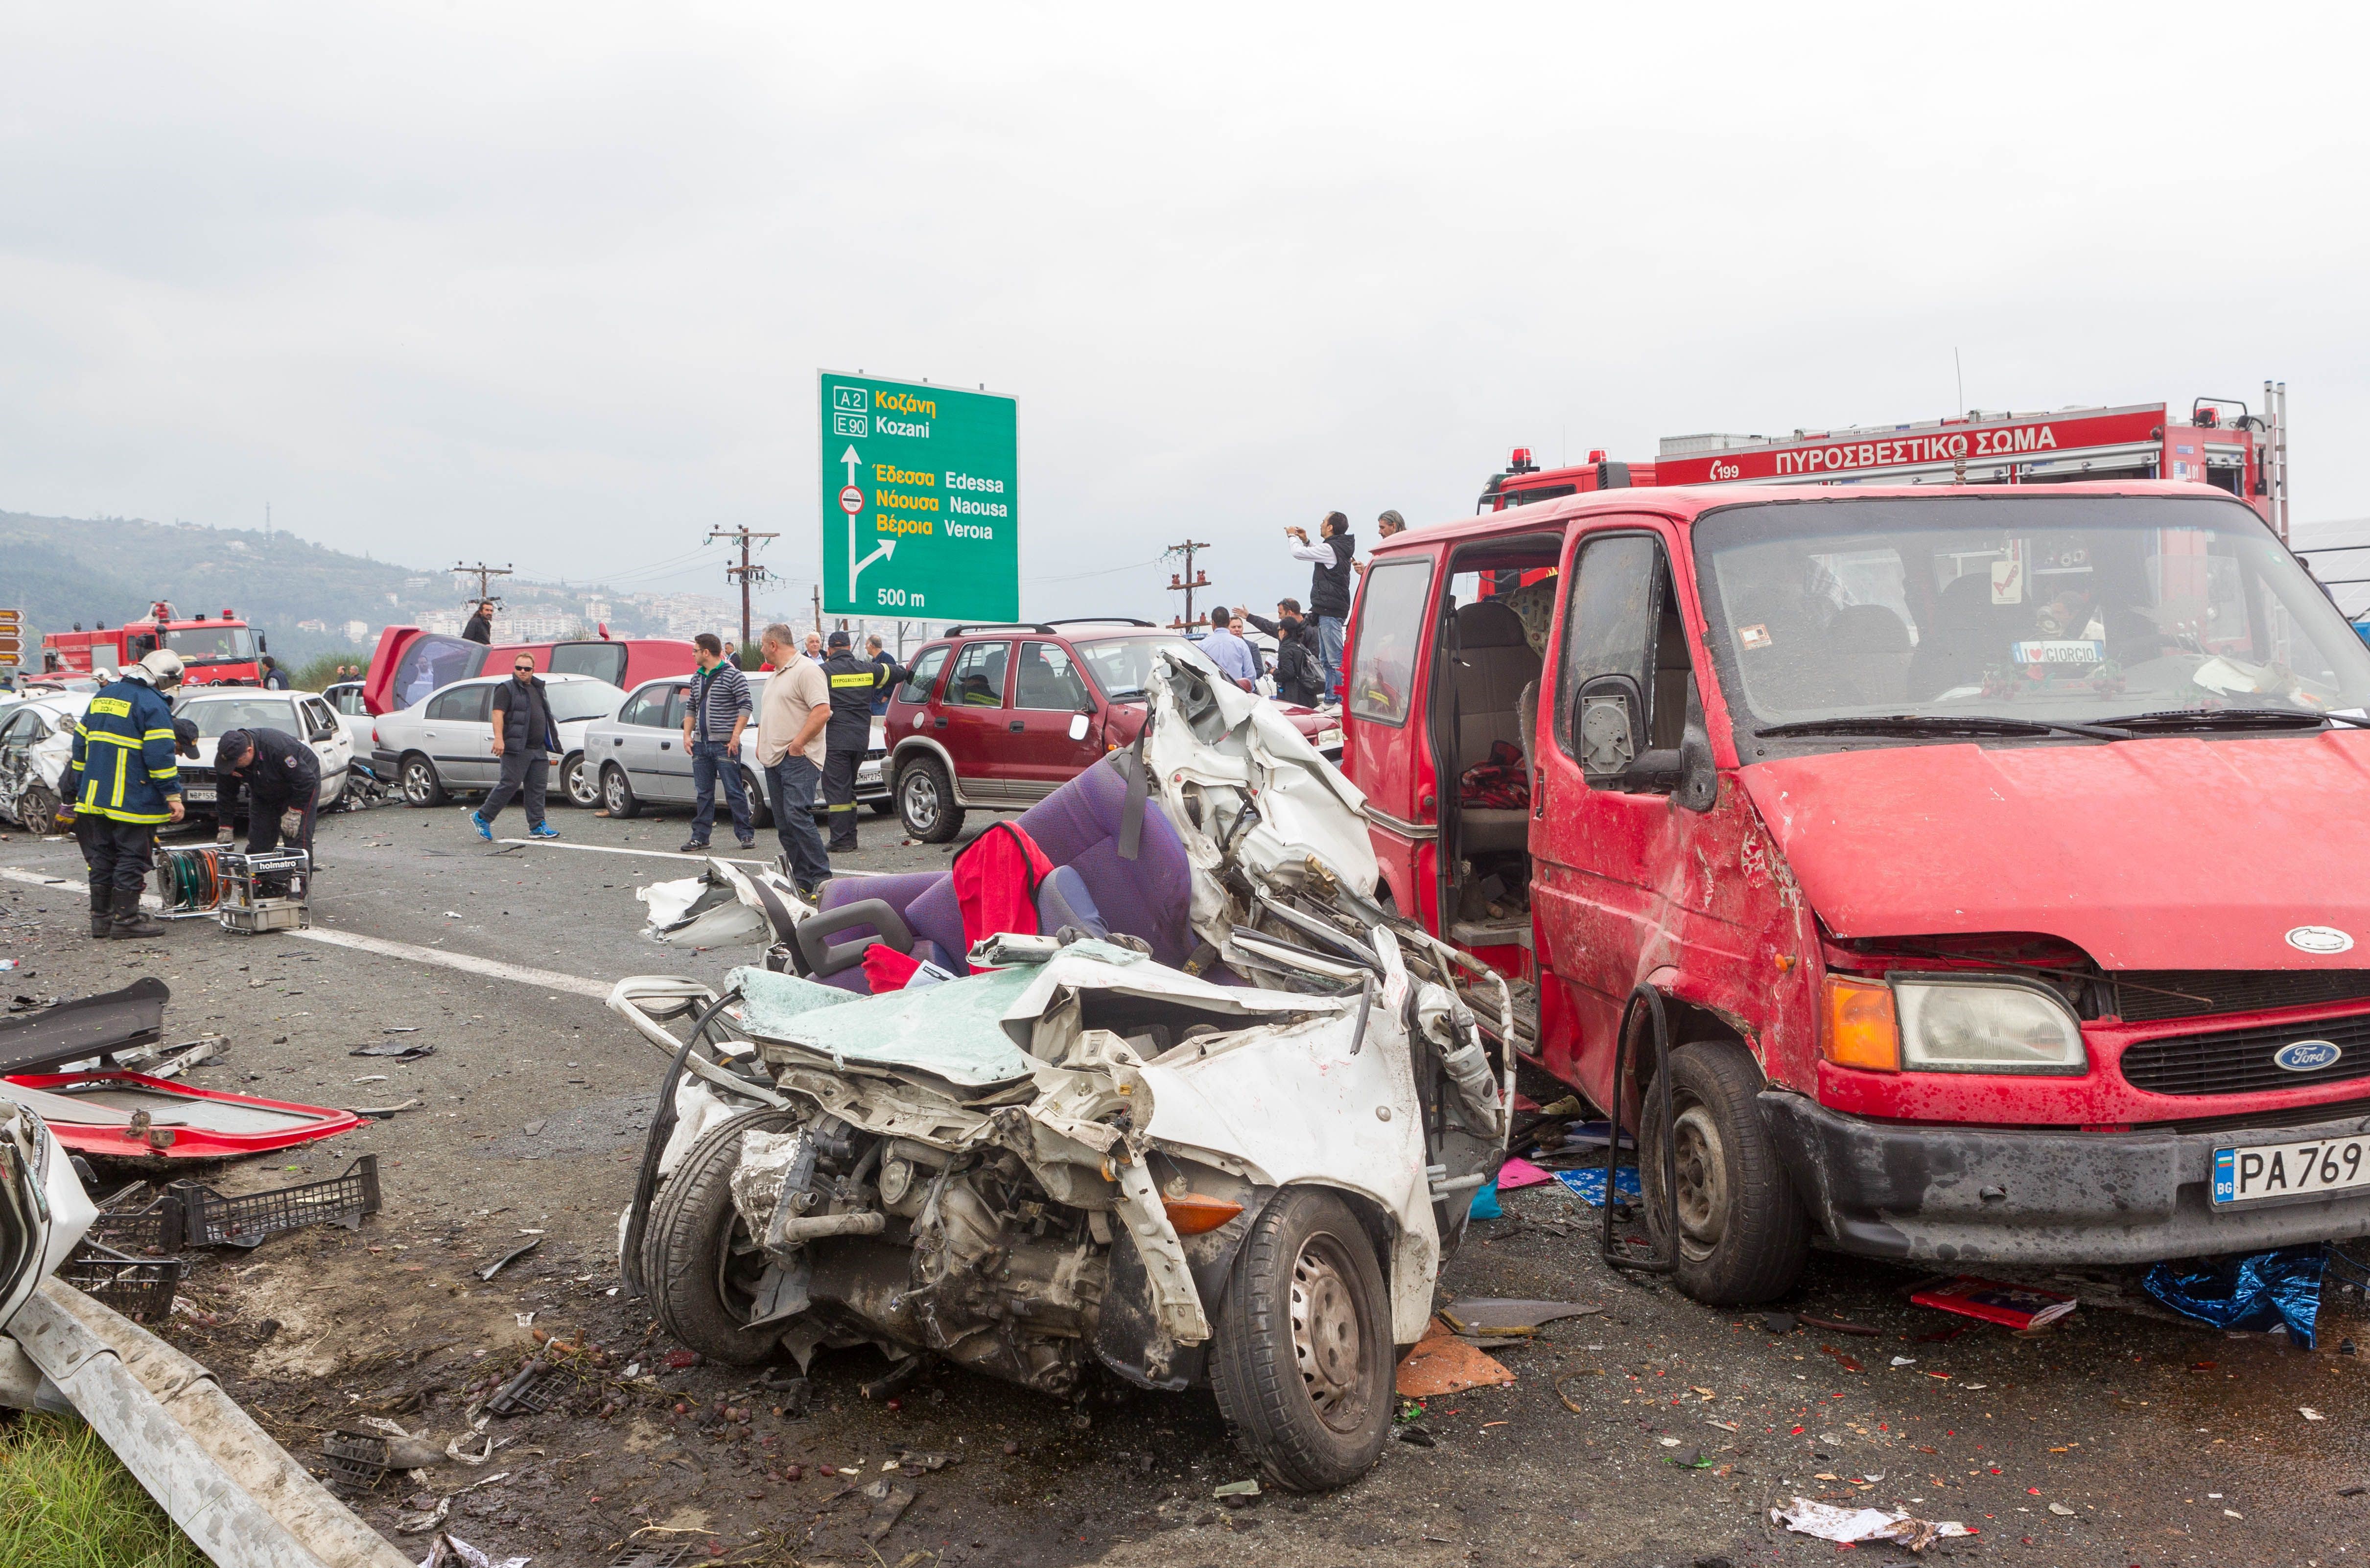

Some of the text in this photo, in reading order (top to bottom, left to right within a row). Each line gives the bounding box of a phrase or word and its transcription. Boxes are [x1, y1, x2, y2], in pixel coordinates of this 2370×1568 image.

[875, 390, 936, 419] Κοζάνη
[876, 416, 930, 438] Kozani
[1717, 425, 2057, 479] 199 ΠΥΡΟΣΒΕΣΤΙΚΟ ΣΩΜΑ
[872, 464, 934, 486] Έδεσσα
[945, 471, 1004, 493] Edessa
[876, 489, 939, 511] Νάουσα
[950, 496, 1008, 517] Naousa
[877, 514, 933, 537] Βέροια
[944, 519, 993, 539] Veroia
[878, 588, 925, 607] 500 m
[2045, 647, 2094, 662] GIORGIO
[259, 860, 297, 870] holmatro
[2291, 1046, 2326, 1064] Ford
[2240, 1142, 2370, 1193] PA 769
[2217, 1181, 2232, 1195] BG
